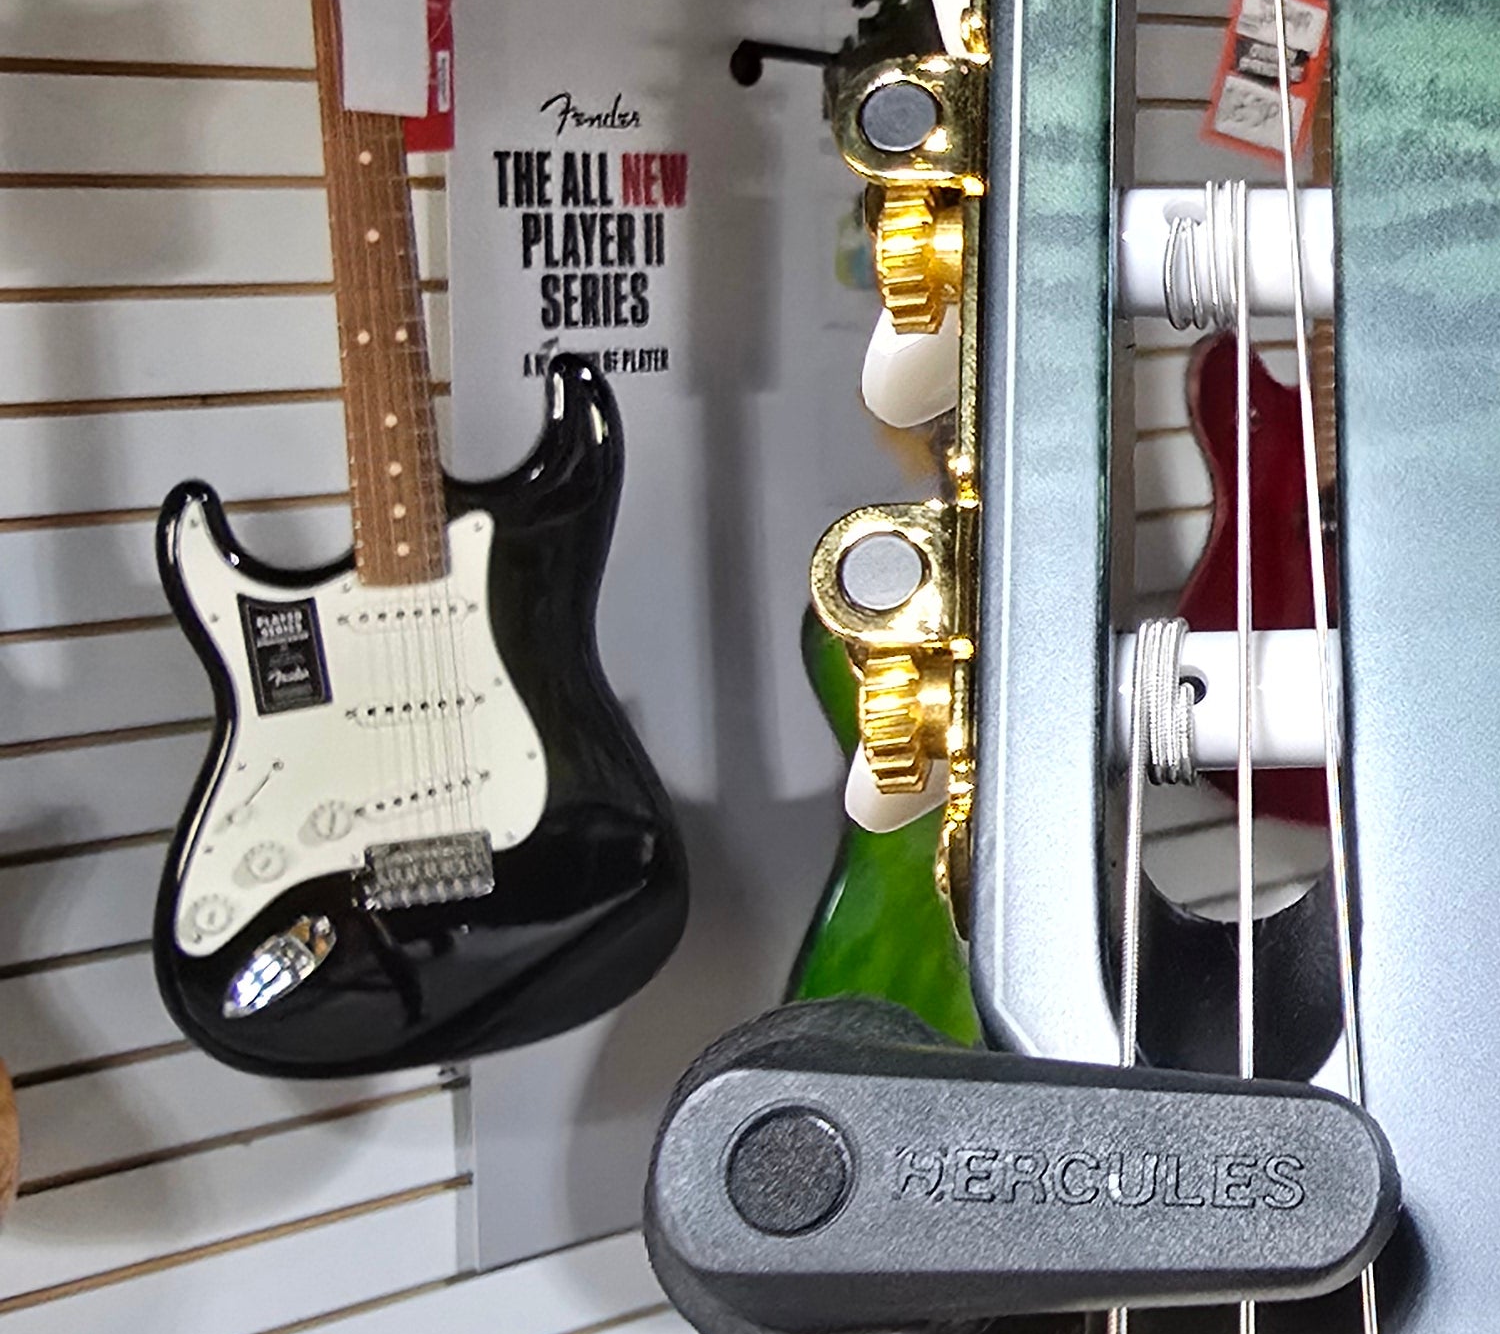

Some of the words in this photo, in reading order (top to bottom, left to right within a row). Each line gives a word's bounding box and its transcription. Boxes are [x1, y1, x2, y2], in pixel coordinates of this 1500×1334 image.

[540, 92, 642, 137] Fender
[493, 151, 552, 208] THE
[561, 151, 614, 208] ALL
[621, 152, 688, 208] NEW
[521, 212, 636, 268] PLAYER
[643, 212, 665, 267] II
[540, 271, 650, 330] SERIES
[892, 1145, 1306, 1211] HERCULES
